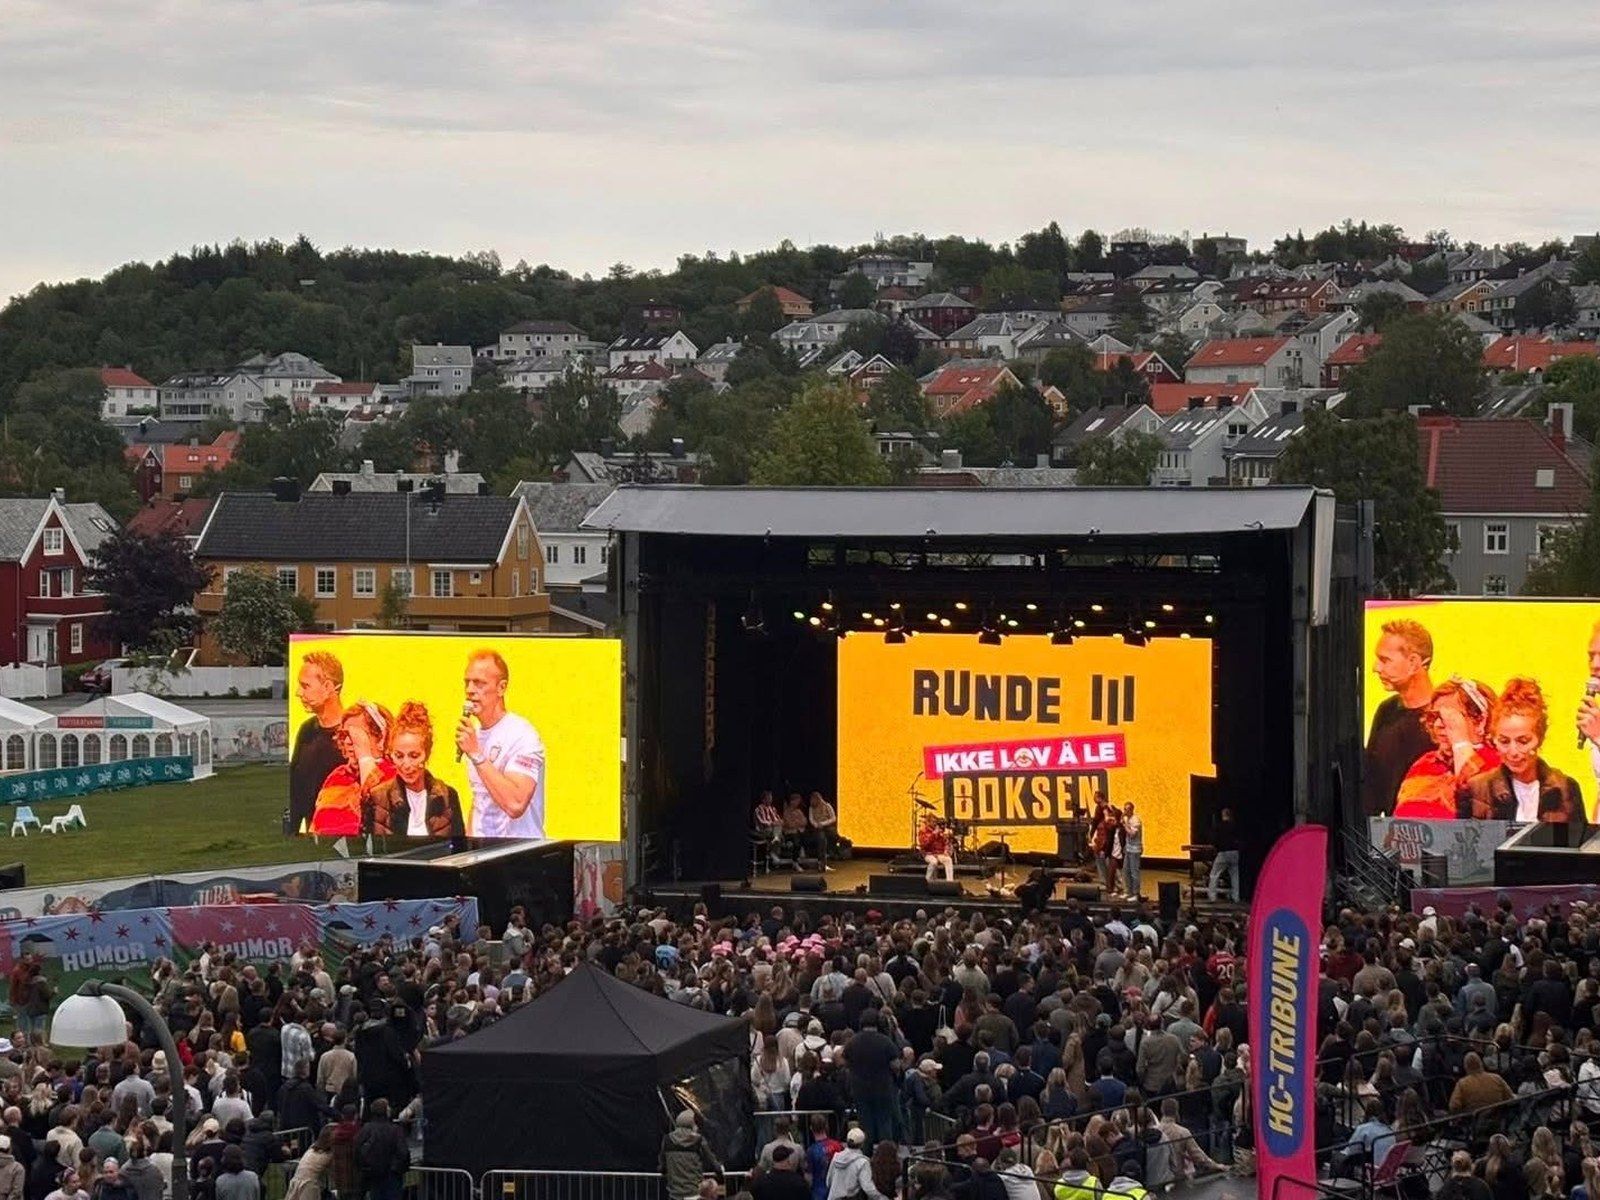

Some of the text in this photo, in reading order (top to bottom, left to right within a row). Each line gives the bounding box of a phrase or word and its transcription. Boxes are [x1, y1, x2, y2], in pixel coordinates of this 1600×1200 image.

[913, 669, 1136, 726] RUNDE III
[935, 751, 994, 773] IKKE
[1057, 741, 1079, 765] Å
[1084, 742, 1117, 763] LE
[953, 775, 1099, 820] BOKSEN
[62, 942, 146, 972] HUMOR
[218, 937, 294, 962] HUMOR
[1217, 963, 1235, 980] 20
[1268, 926, 1300, 1136] HC-TRIBUNE
